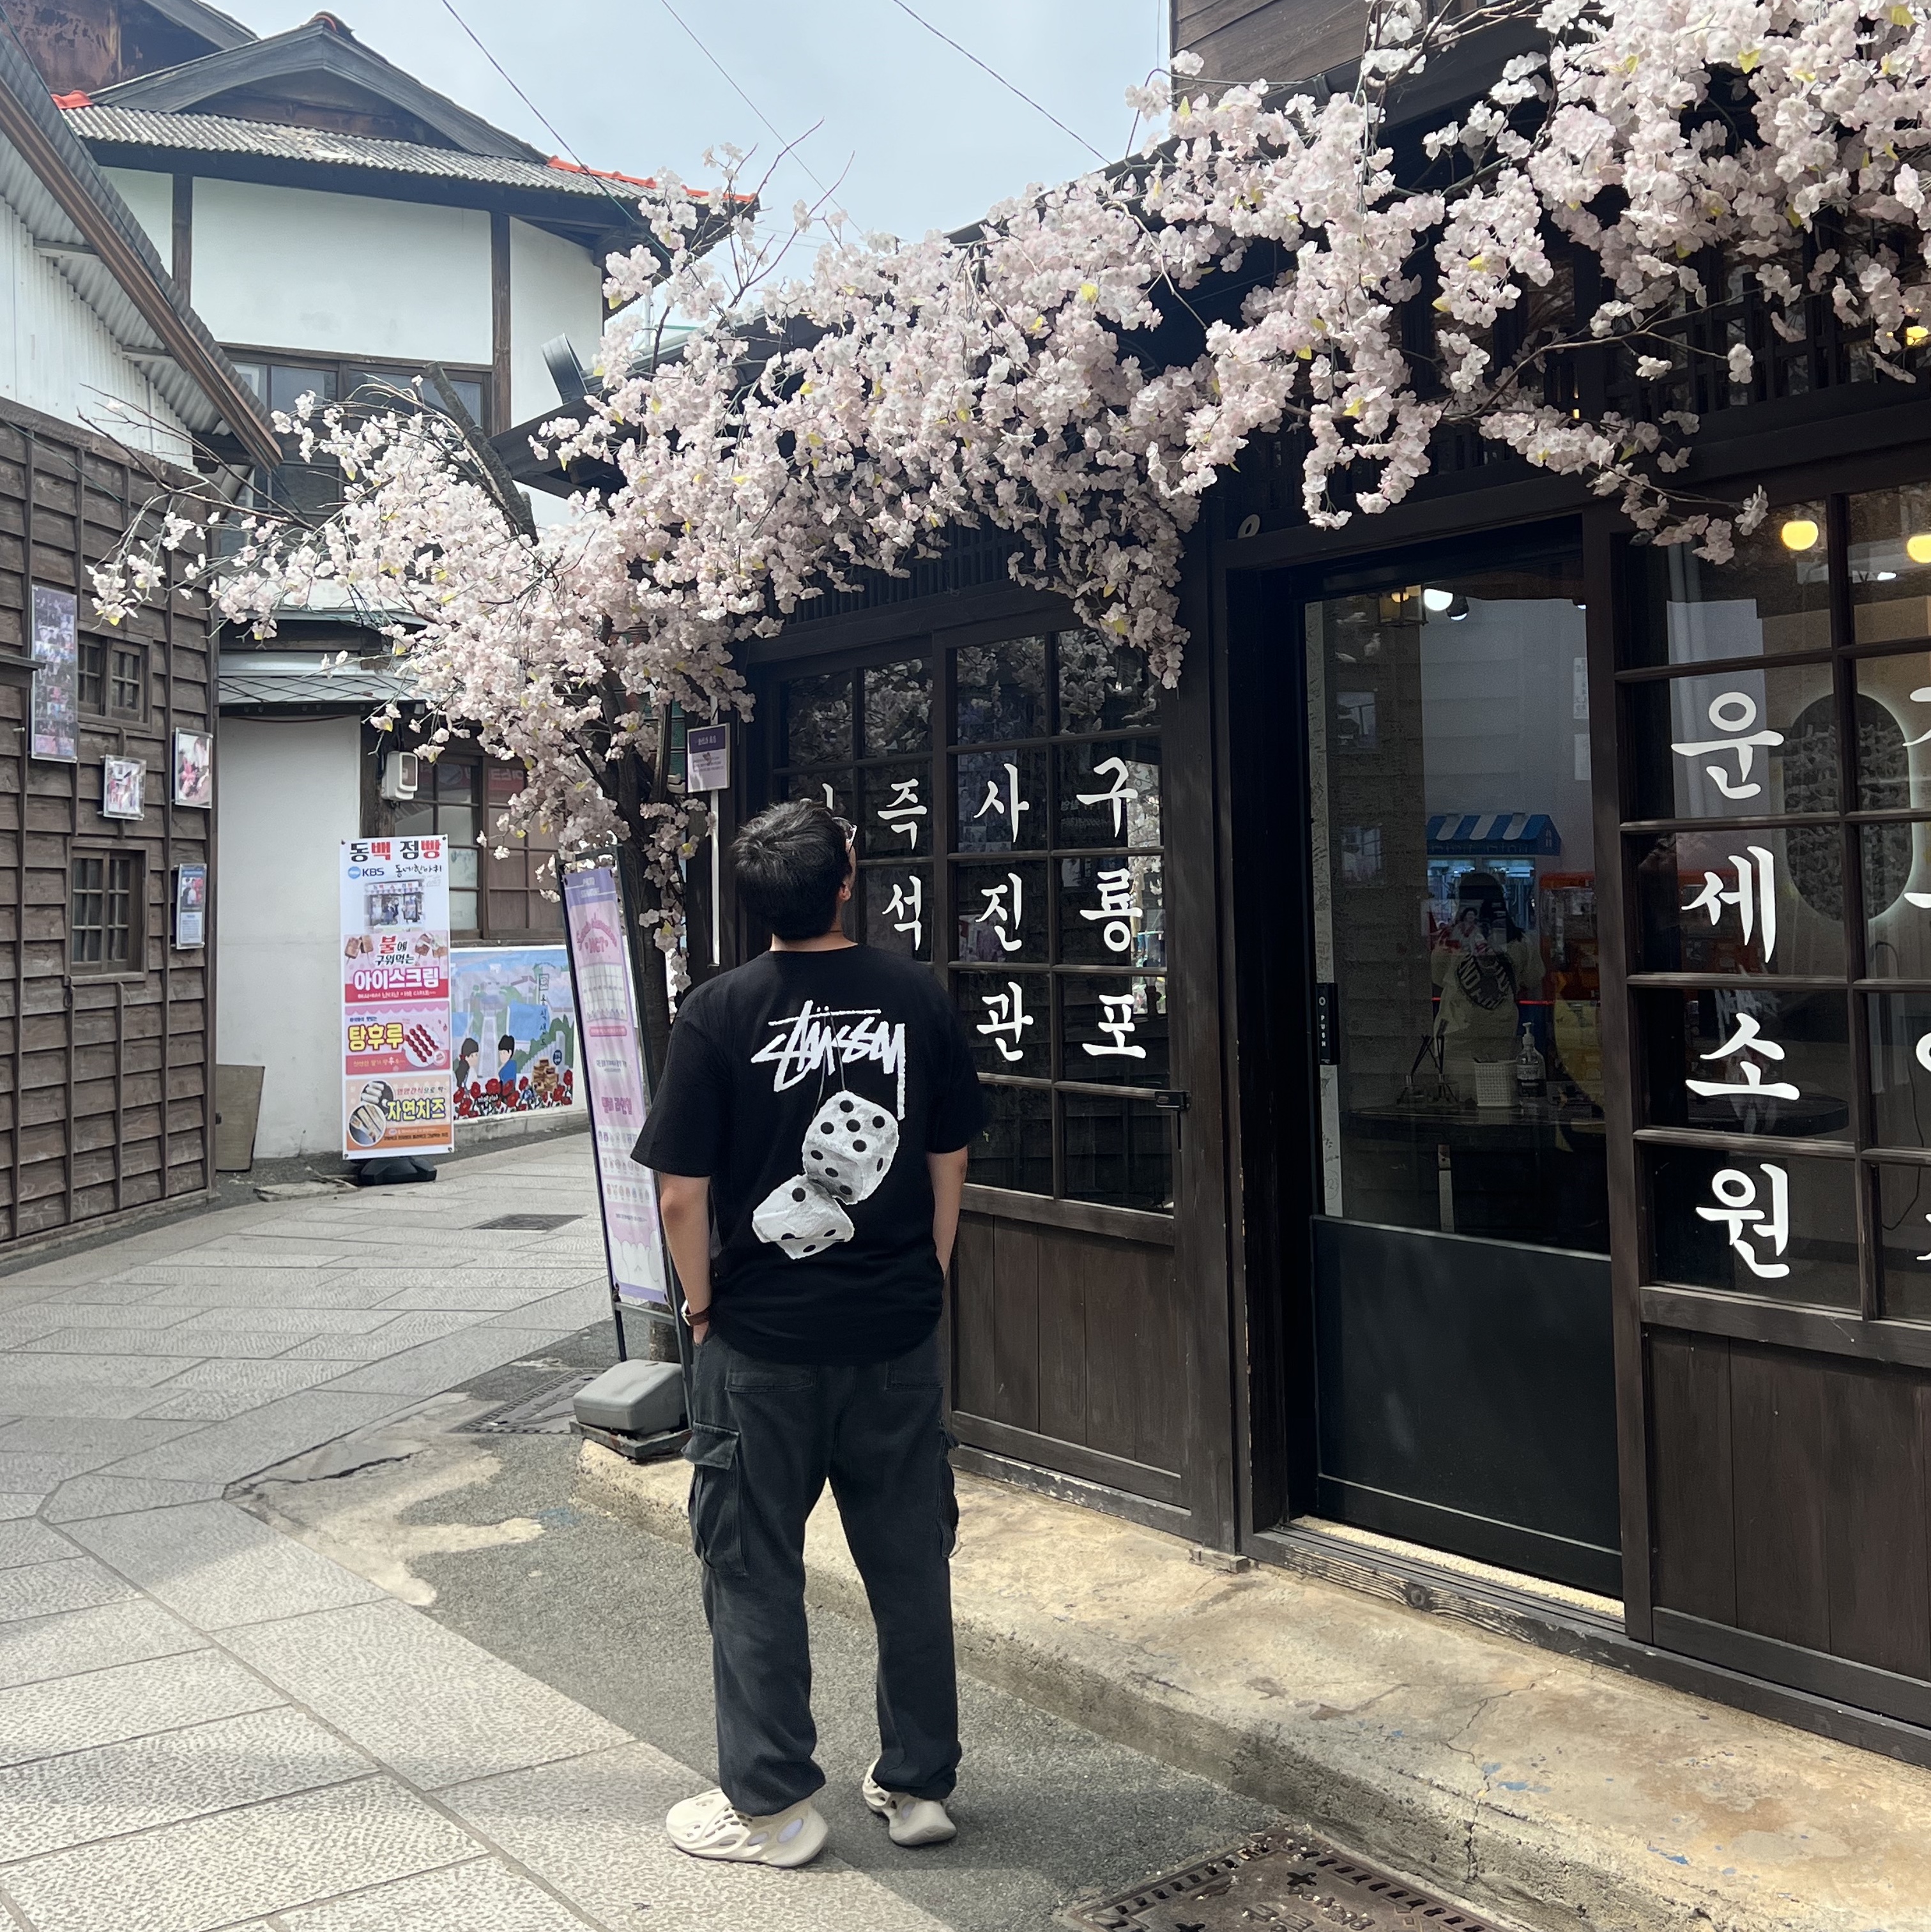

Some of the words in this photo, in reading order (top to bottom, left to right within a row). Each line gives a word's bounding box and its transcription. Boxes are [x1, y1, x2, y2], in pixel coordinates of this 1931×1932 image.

[349, 842, 391, 862] 동백
[399, 839, 441, 860] 점빵
[362, 867, 385, 877] KBS
[353, 966, 439, 991] 아이스크림
[348, 1023, 404, 1051] 탕후루
[386, 1097, 446, 1122] 자연치즈
